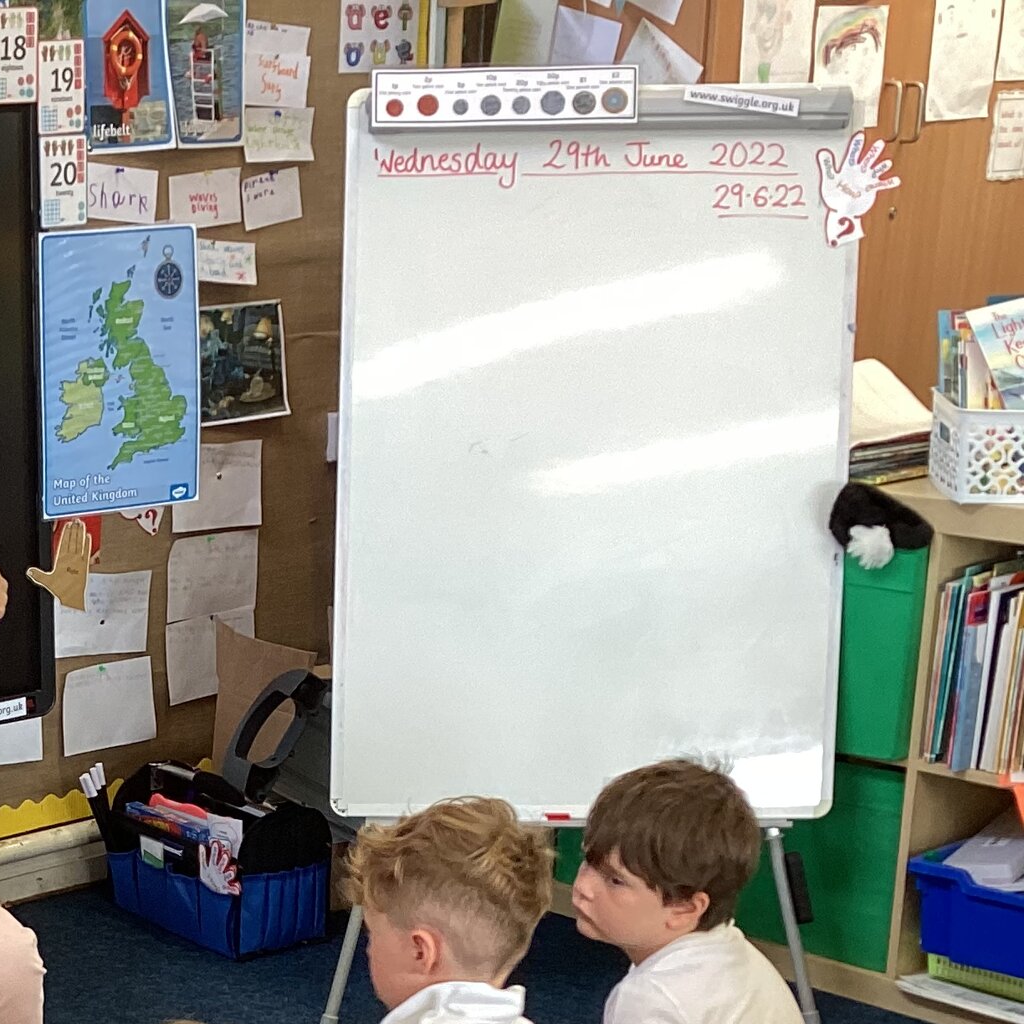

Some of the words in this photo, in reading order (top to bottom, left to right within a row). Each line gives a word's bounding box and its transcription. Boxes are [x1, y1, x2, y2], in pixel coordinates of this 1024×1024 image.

[0, 35, 26, 60] 18
[51, 67, 73, 92] 19
[689, 90, 795, 112] www.swiggle.org.uk
[92, 123, 131, 141] lifebelt
[50, 161, 77, 186] 20
[374, 142, 519, 189] Wednesday
[542, 139, 611, 170] 29th
[624, 141, 689, 169] June
[709, 141, 789, 168] 2022
[53, 479, 76, 490] Map
[79, 475, 91, 489] of
[94, 474, 110, 485] the
[53, 491, 88, 506] United
[92, 488, 137, 502] Kingdom
